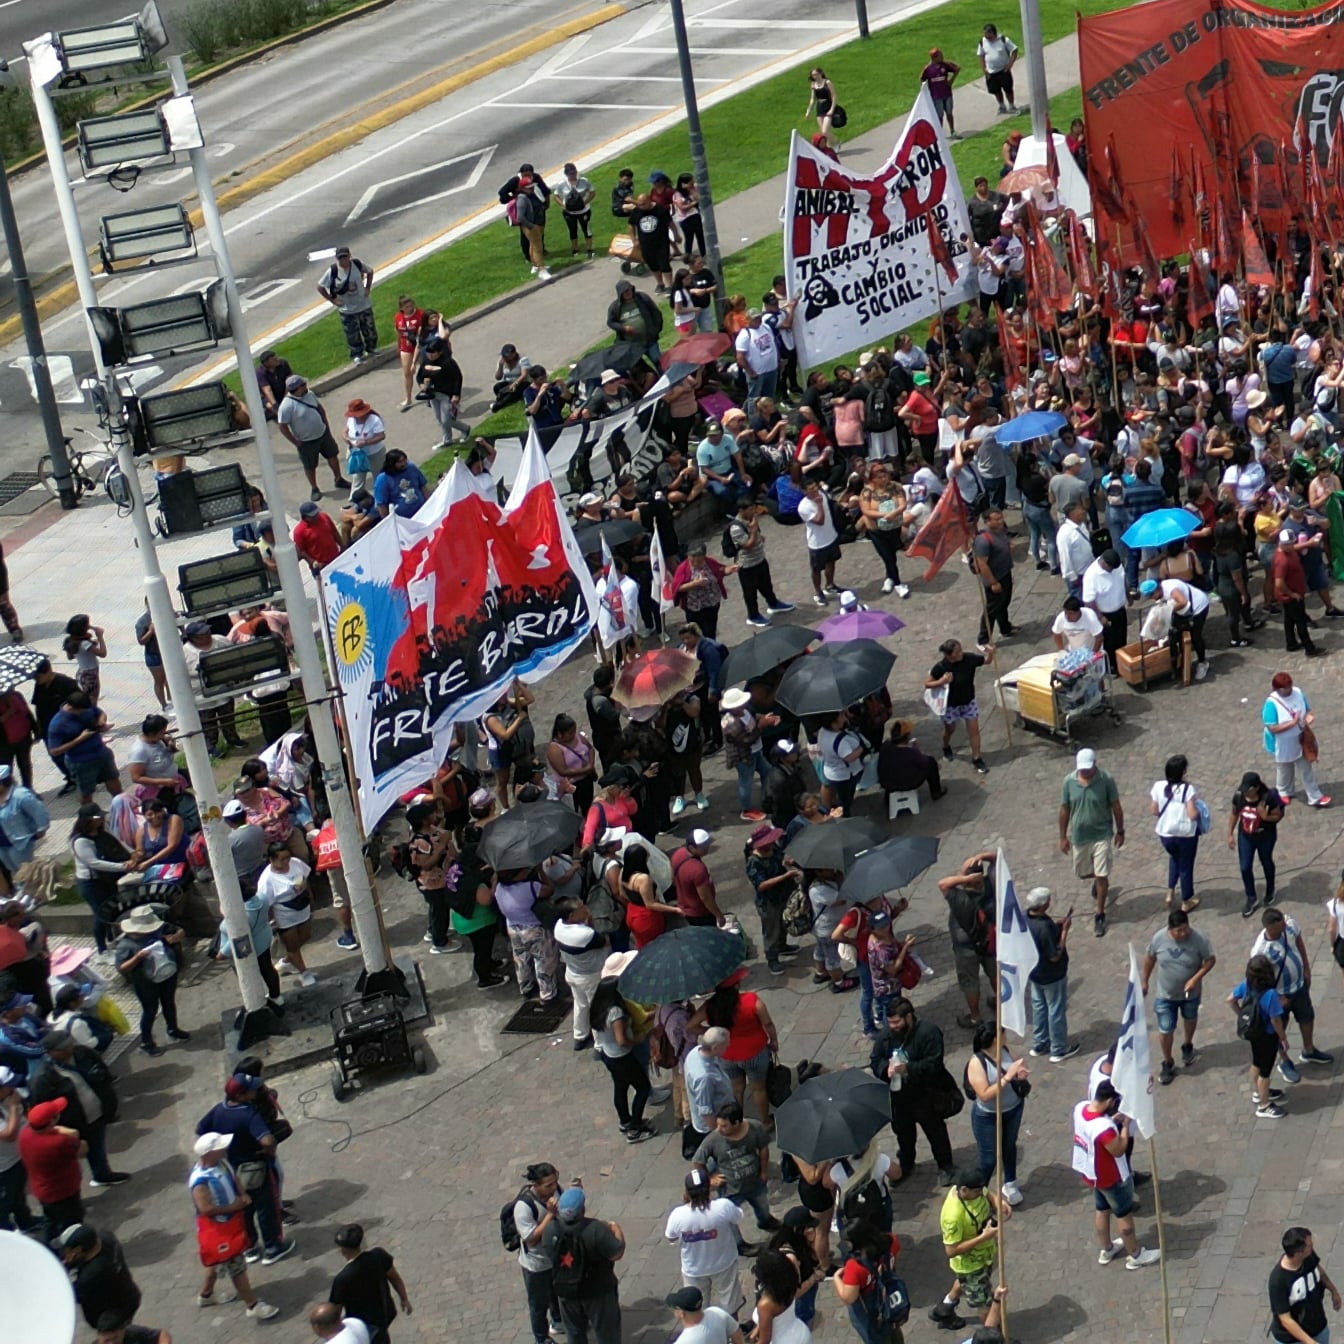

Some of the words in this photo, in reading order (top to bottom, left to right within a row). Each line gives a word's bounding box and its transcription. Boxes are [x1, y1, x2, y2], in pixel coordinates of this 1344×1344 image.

[1087, 41, 1174, 111] FRENTE
[1170, 18, 1203, 55] DE
[796, 238, 879, 280] TRABAJO,
[868, 253, 880, 275] Y
[841, 261, 907, 306] CAMBIO
[856, 279, 923, 326] SOCIAL
